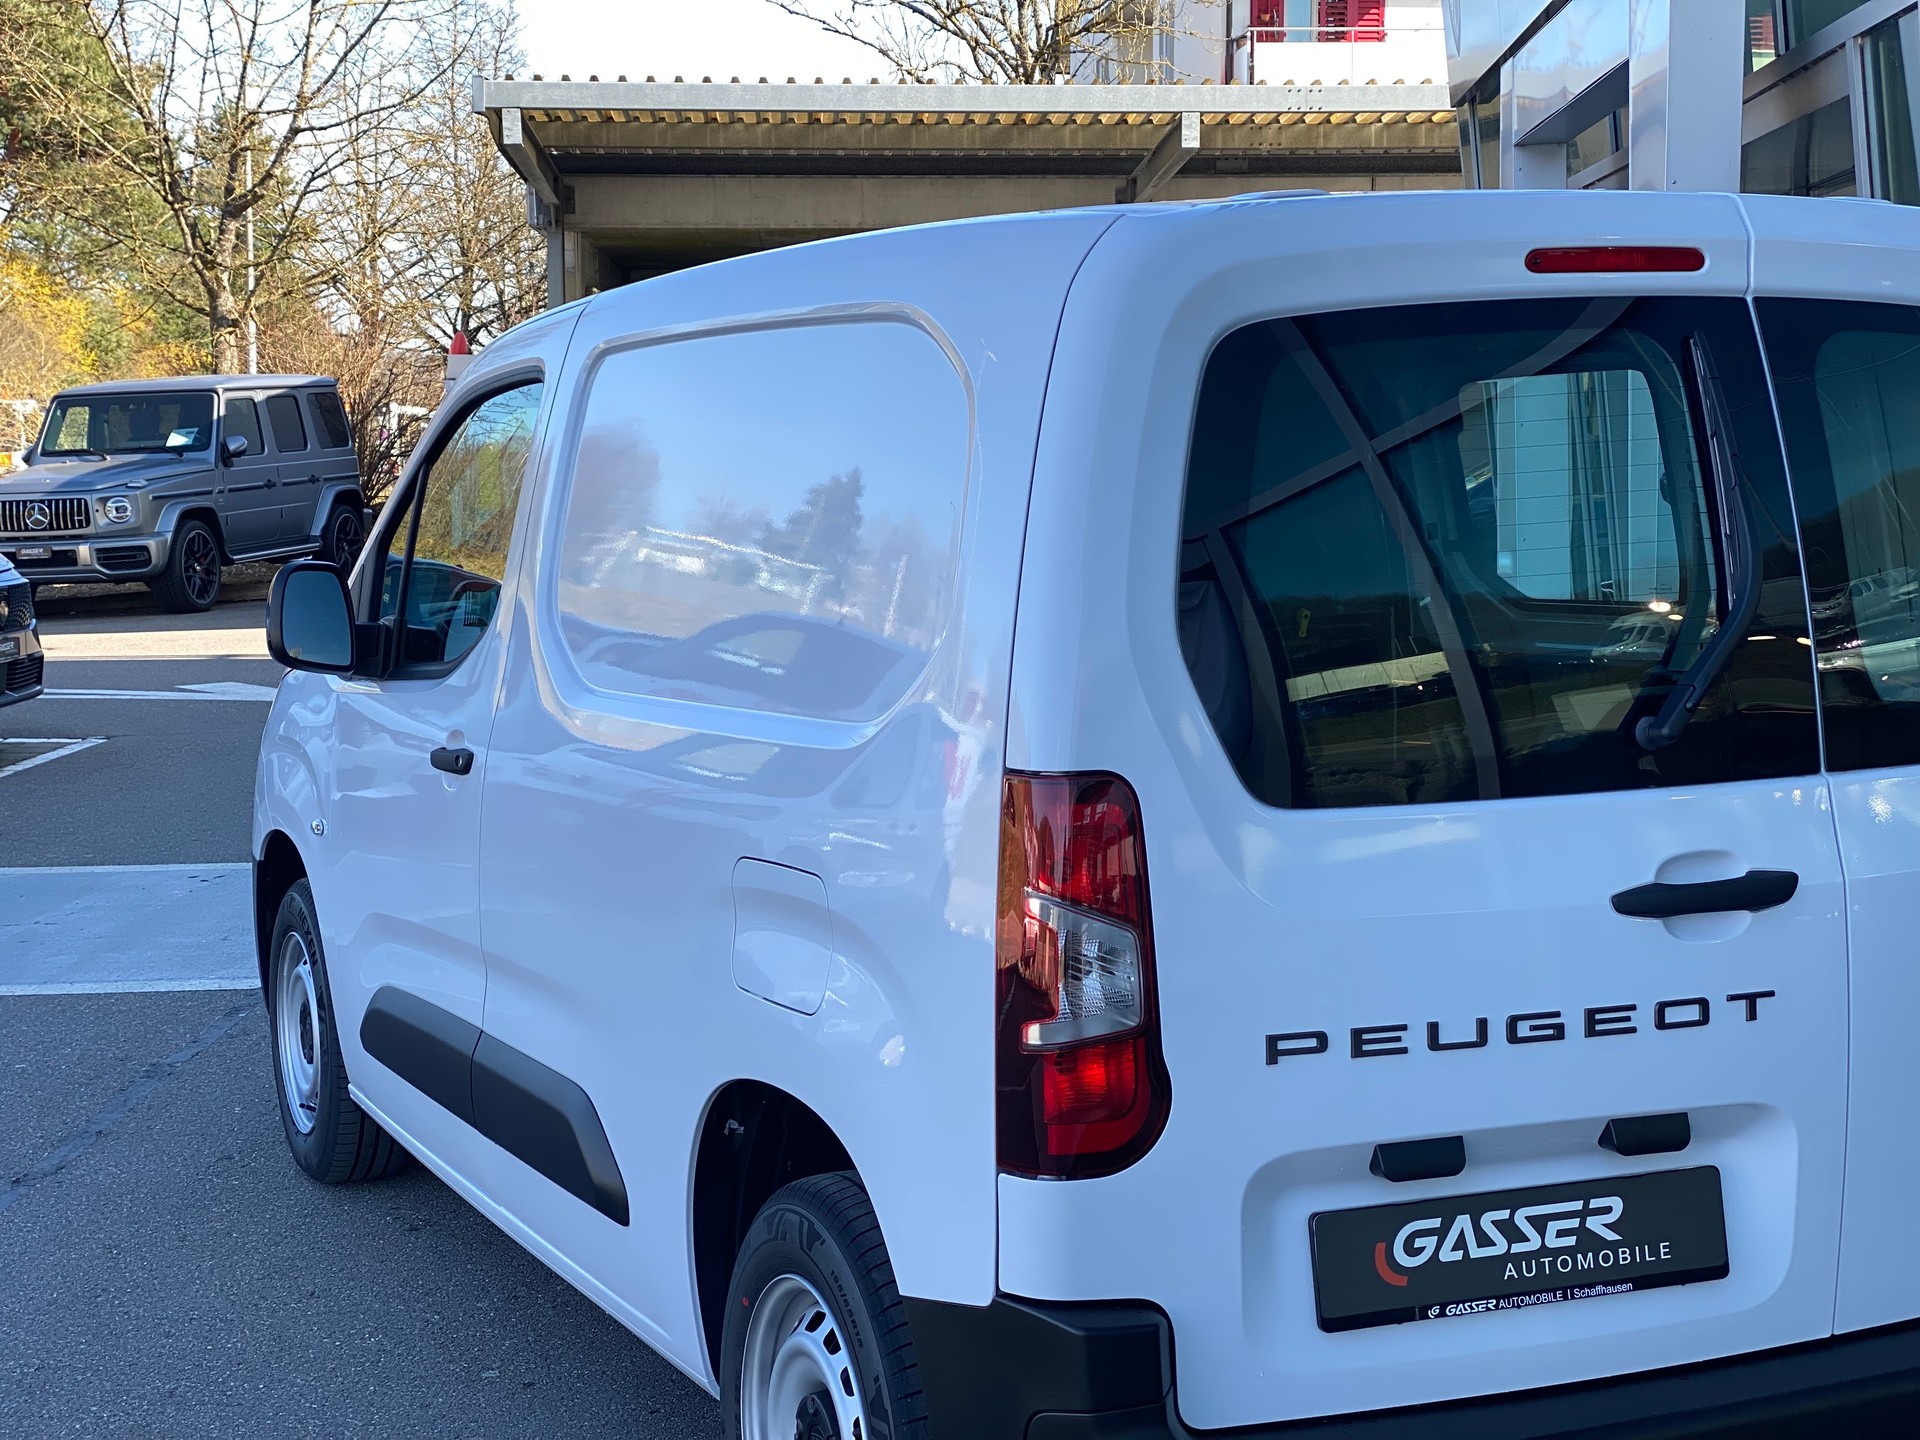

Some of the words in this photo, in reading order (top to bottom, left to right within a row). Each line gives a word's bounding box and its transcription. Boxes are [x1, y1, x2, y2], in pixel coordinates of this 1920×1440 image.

[297, 906, 318, 968] NEXEN
[1265, 989, 1776, 1065] PEUGEOT
[1393, 1195, 1624, 1268] GASSER
[1504, 1242, 1671, 1280] AUTOMOBILE
[1445, 1299, 1497, 1316] GASSER
[1499, 1290, 1563, 1309] AUTOMOBILE
[1573, 1281, 1633, 1299] Schaffhausen
